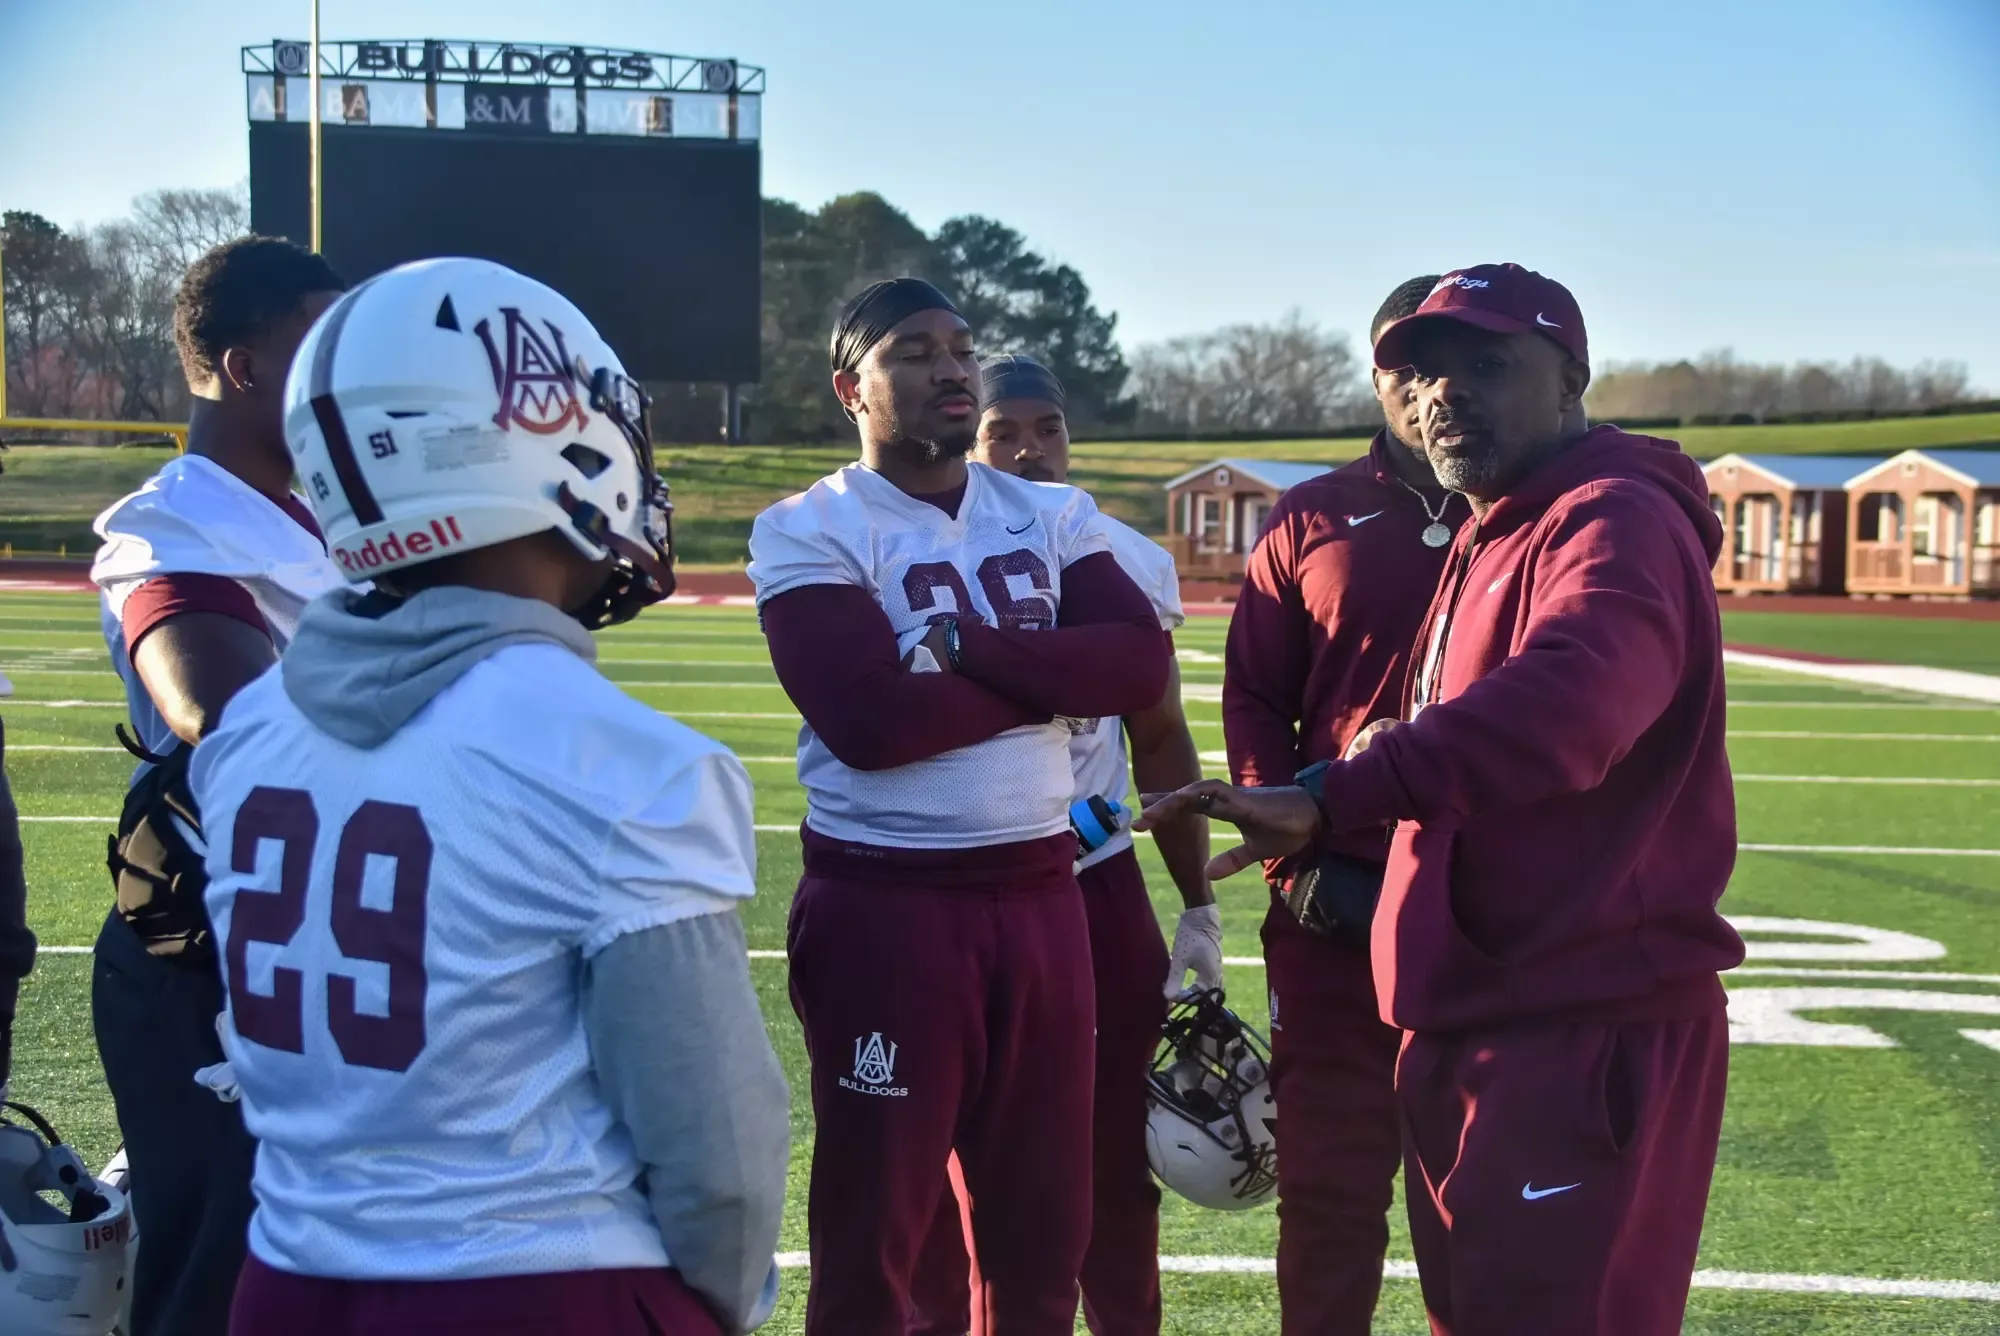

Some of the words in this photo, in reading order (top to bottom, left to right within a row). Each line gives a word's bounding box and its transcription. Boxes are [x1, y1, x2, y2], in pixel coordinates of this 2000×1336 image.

[357, 44, 654, 82] BULLDOGS
[251, 84, 435, 121] ALBAMA
[367, 429, 399, 460] 51
[335, 515, 463, 572] Riddell
[225, 785, 434, 1074] 29
[838, 1077, 908, 1097] BULLDOGS
